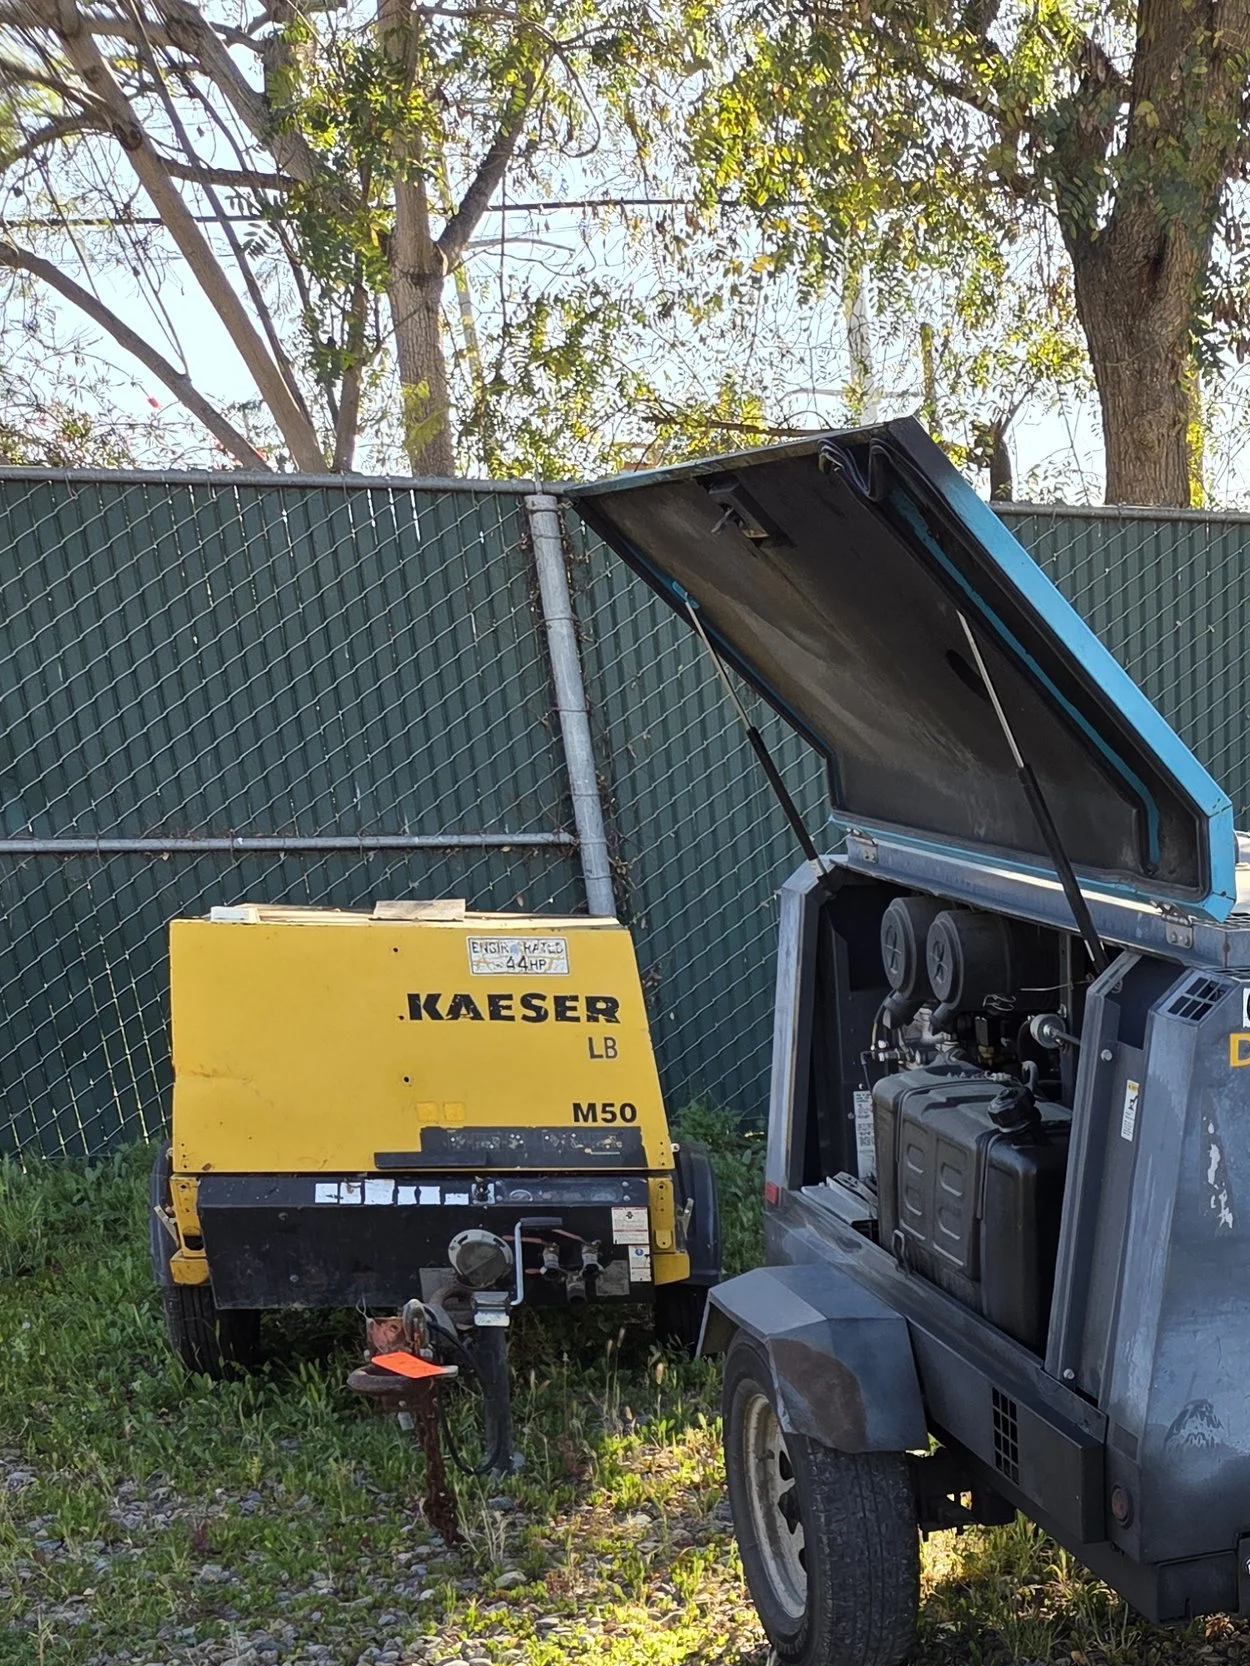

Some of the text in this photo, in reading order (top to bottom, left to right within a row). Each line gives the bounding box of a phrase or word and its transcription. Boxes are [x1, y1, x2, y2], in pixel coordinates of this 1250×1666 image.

[406, 992, 621, 1024] KAESER
[587, 1036, 618, 1060] LB
[572, 1102, 637, 1124] M50
